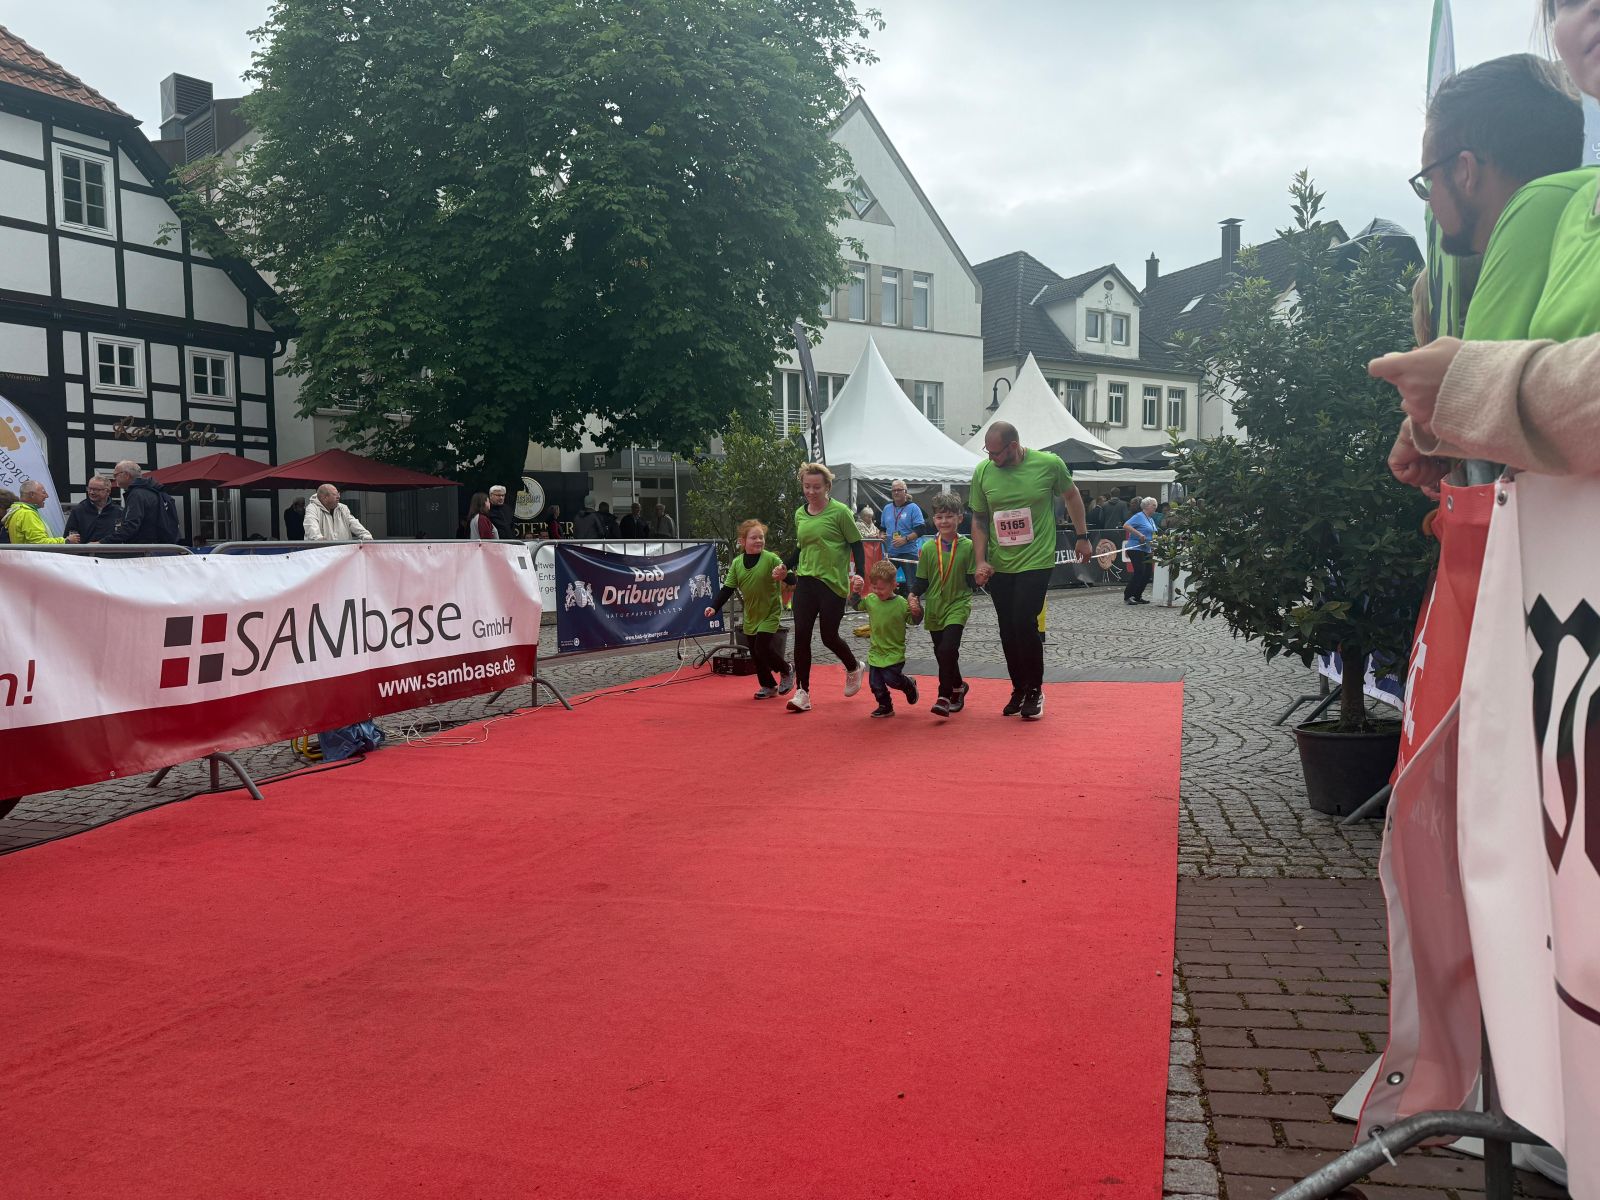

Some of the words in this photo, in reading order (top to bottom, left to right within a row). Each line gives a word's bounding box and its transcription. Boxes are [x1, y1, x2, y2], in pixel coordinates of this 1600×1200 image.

[1000, 519, 1025, 531] 5165
[630, 566, 665, 582] Bad
[601, 584, 681, 607] Driburger
[231, 597, 462, 677] SAMbase
[472, 616, 513, 639] GmbH
[378, 654, 516, 699] www.sambase.de
